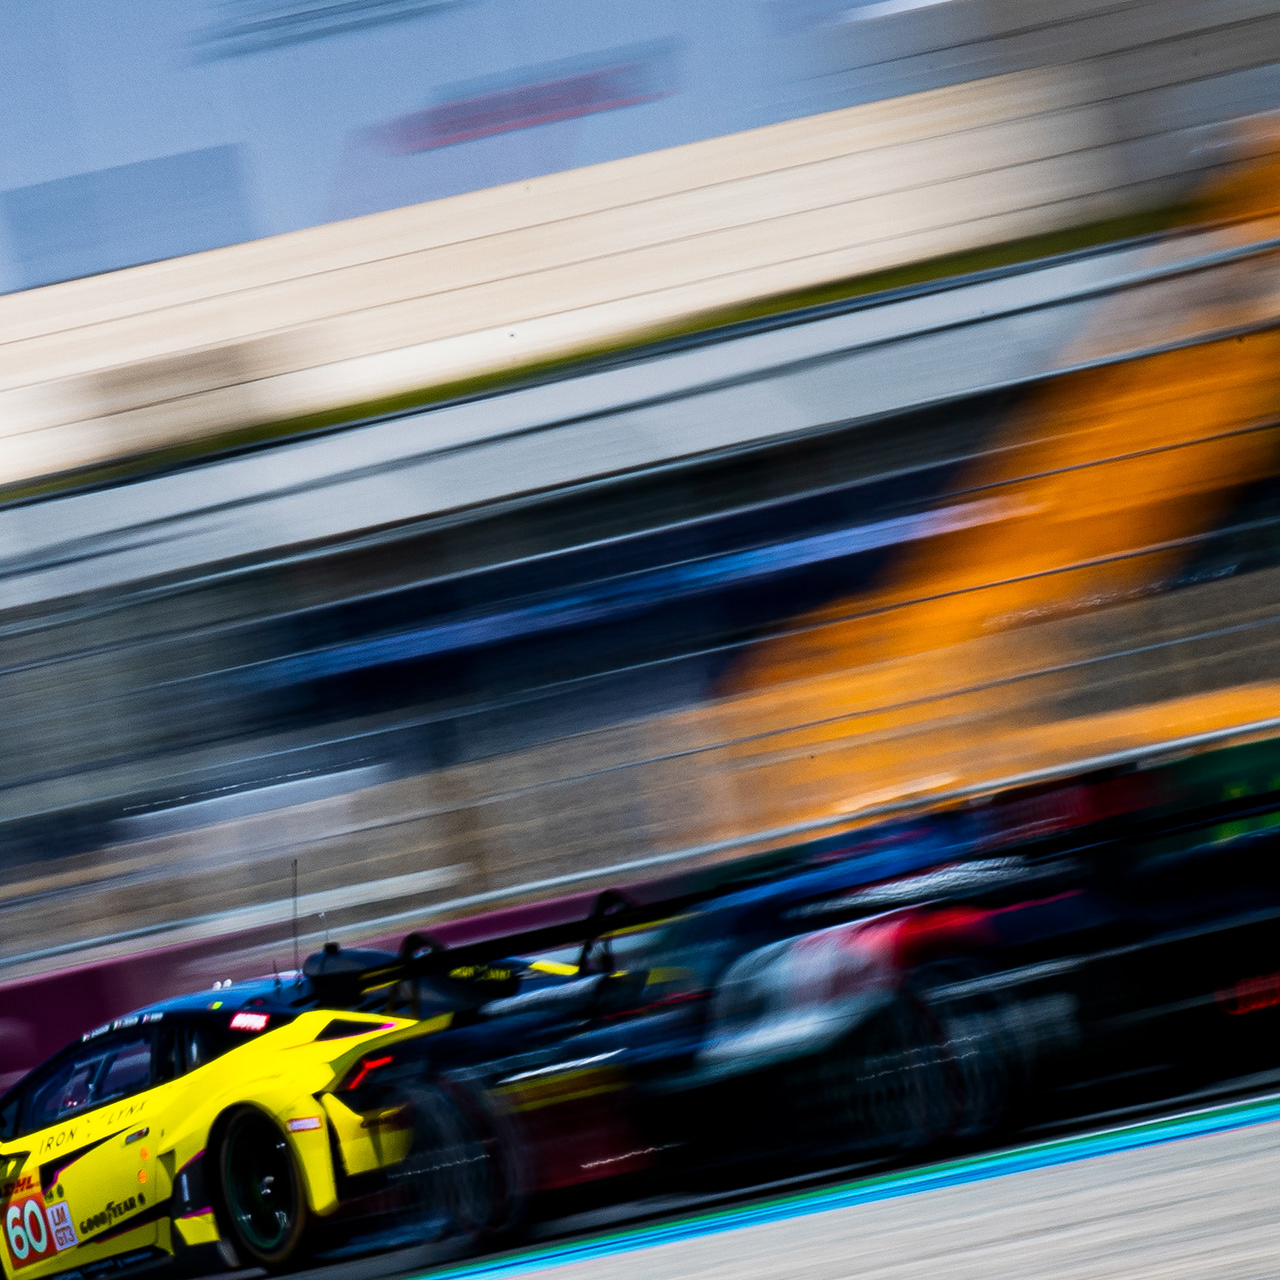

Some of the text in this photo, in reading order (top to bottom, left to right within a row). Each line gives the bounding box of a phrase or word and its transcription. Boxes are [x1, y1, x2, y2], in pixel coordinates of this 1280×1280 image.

[38, 1100, 149, 1155] IRON LYNX
[6, 1199, 47, 1259] 60
[50, 1205, 66, 1226] LM
[79, 1197, 136, 1234] GOODYEAR
[54, 1225, 75, 1247] GT3
